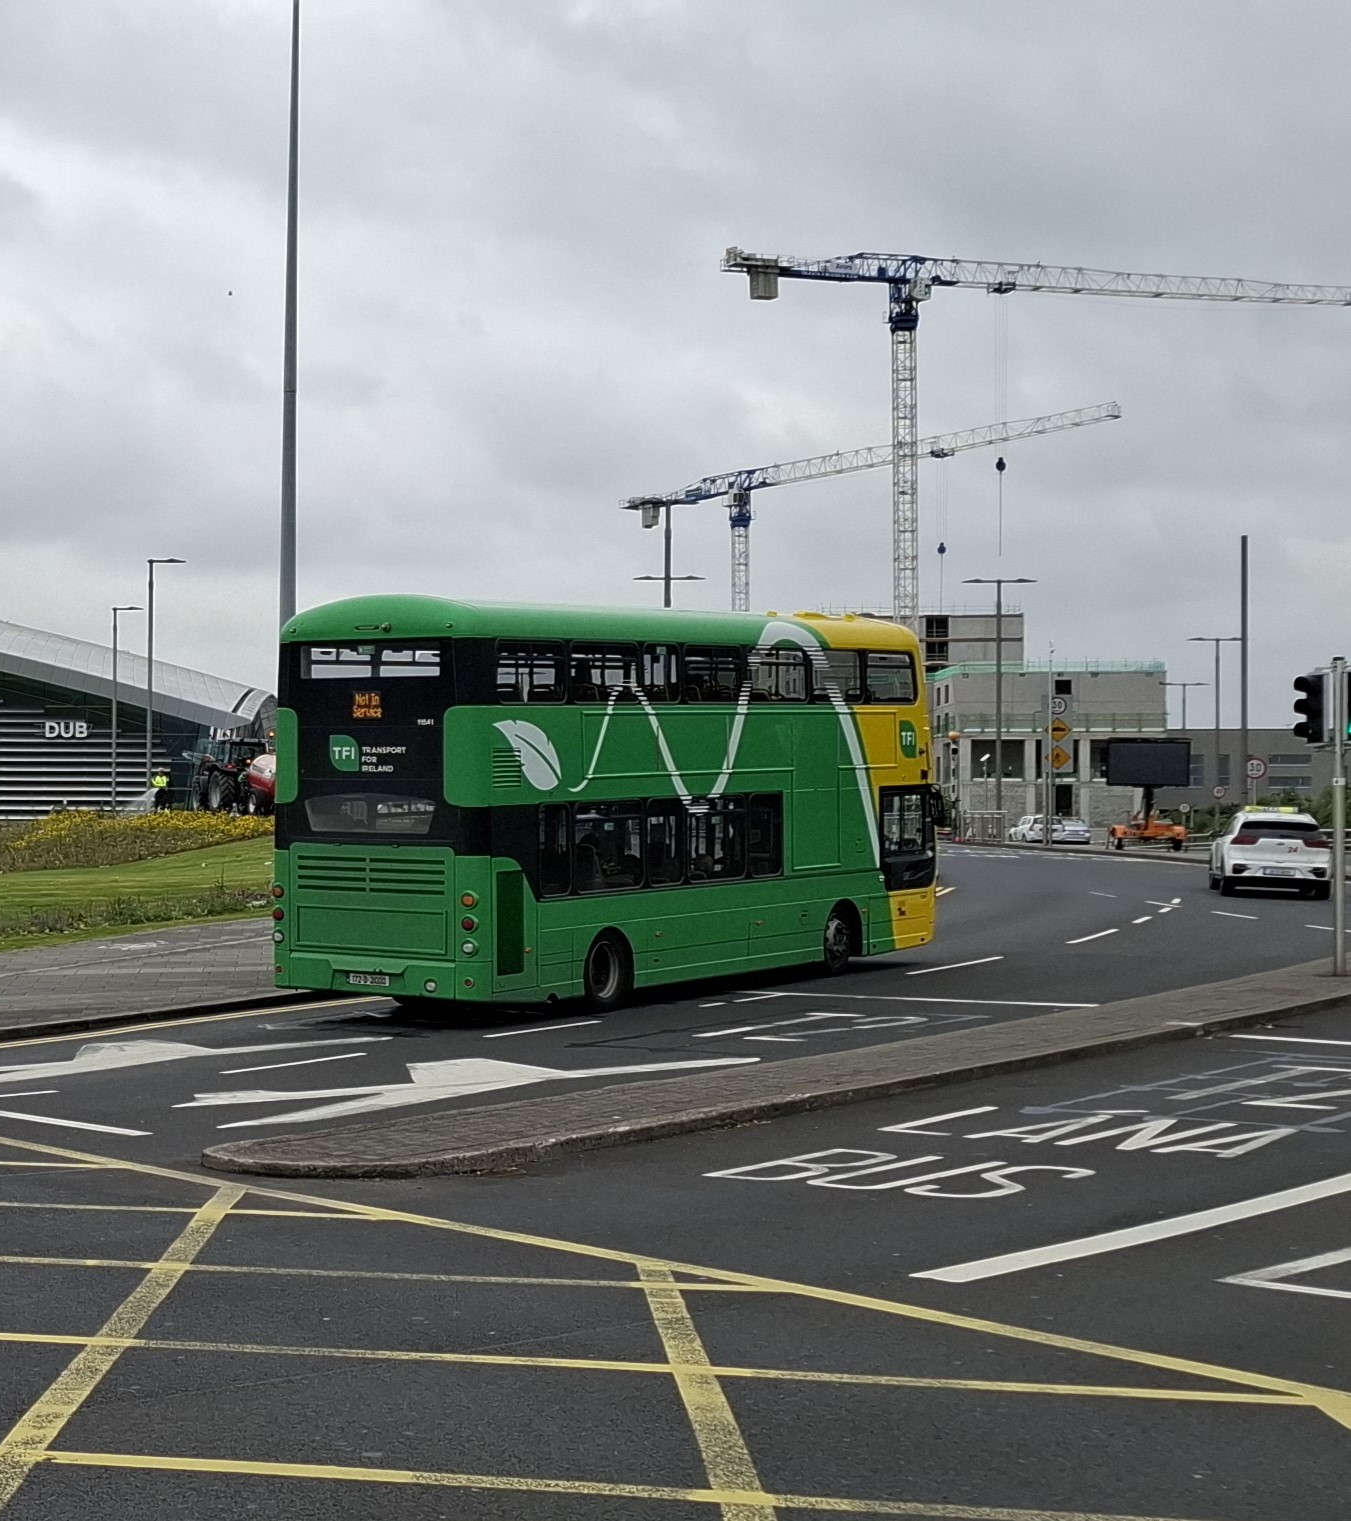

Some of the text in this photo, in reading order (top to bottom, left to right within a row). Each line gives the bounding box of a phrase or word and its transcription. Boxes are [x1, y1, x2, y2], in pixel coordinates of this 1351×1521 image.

[355, 693, 369, 705] Not
[353, 705, 383, 718] Service
[45, 721, 88, 738] DUB
[901, 731, 915, 745] TFI
[333, 747, 356, 759] TFI
[1249, 763, 1262, 772] 30
[701, 1148, 1097, 1198] BUS
